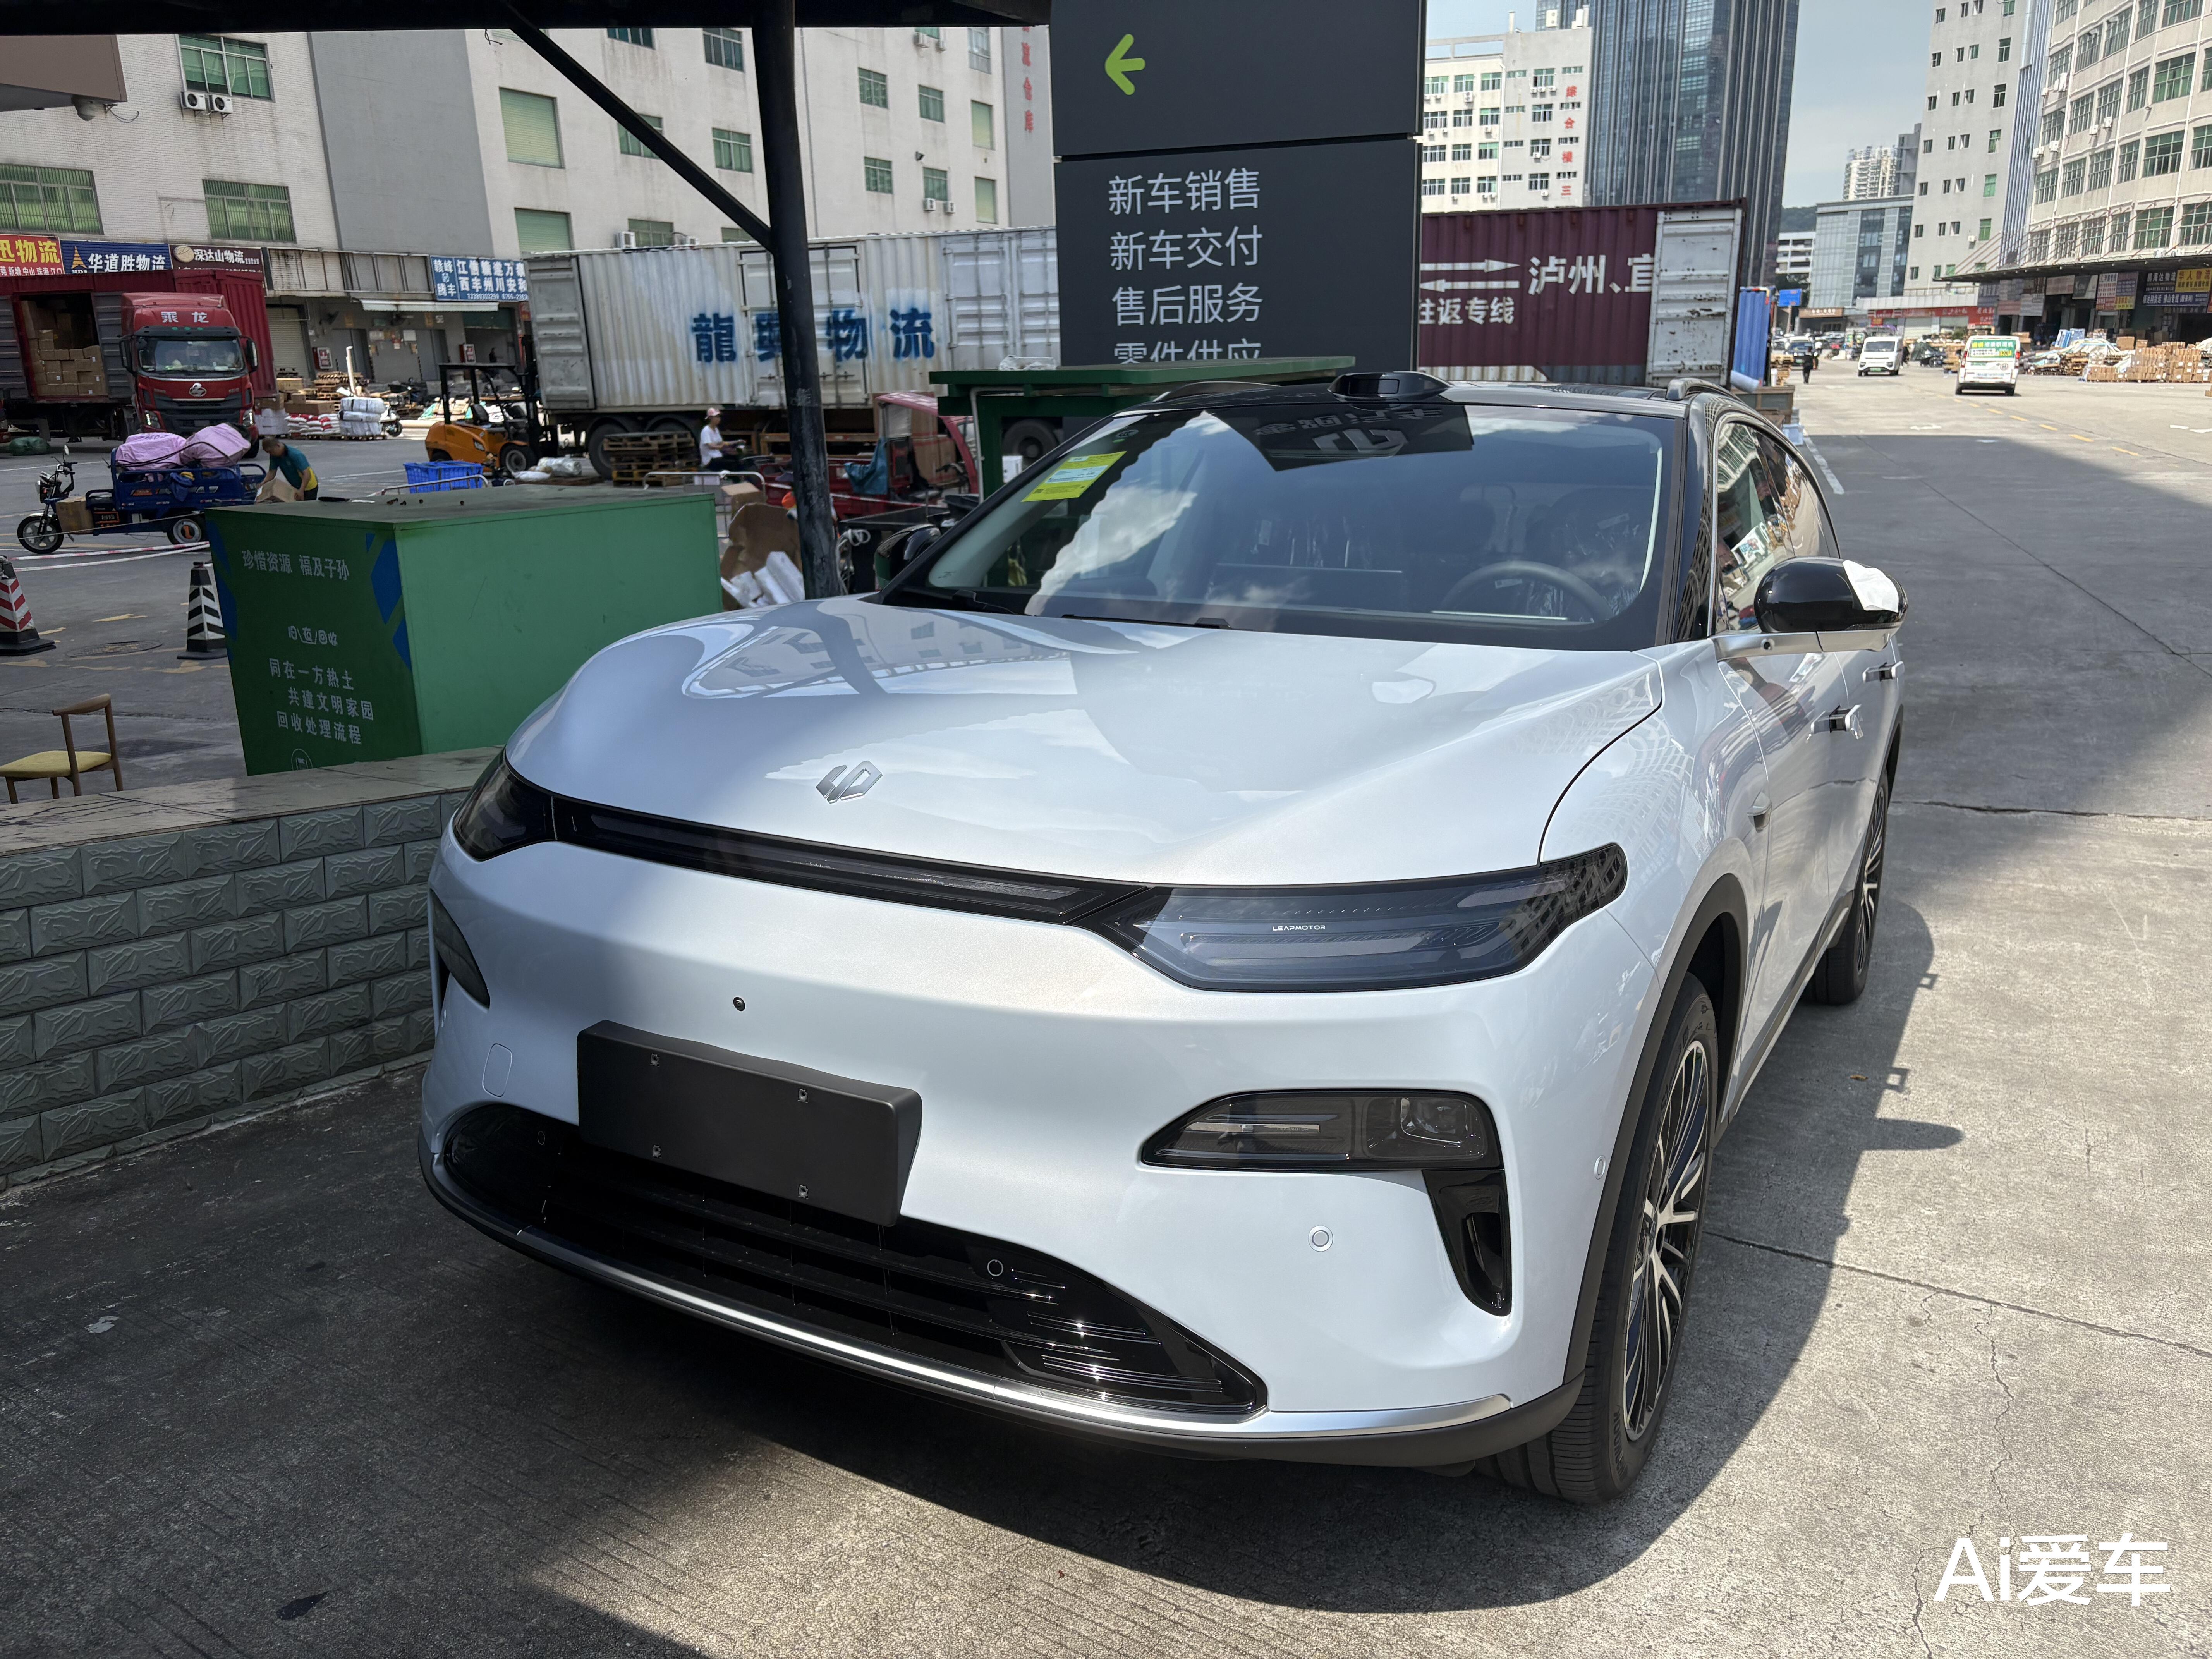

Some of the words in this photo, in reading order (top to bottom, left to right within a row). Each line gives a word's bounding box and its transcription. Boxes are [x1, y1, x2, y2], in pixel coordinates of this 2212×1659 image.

[1108, 168, 1261, 215] 新车销售
[0, 239, 60, 263] 迅物流
[88, 253, 166, 273] 华道胜物流
[1109, 225, 1263, 271] 新车交付
[161, 311, 209, 323] 乘龙
[1112, 282, 1263, 326] 售后服务
[1418, 296, 1515, 326] 往返专线
[1114, 338, 1262, 364] 零件供应
[242, 549, 292, 574] 珍惜资源
[299, 555, 349, 581] 福及子孙
[269, 658, 354, 690] 同在一方热土
[288, 687, 374, 721] 共建文明家园
[276, 711, 362, 745] 回收处理流程
